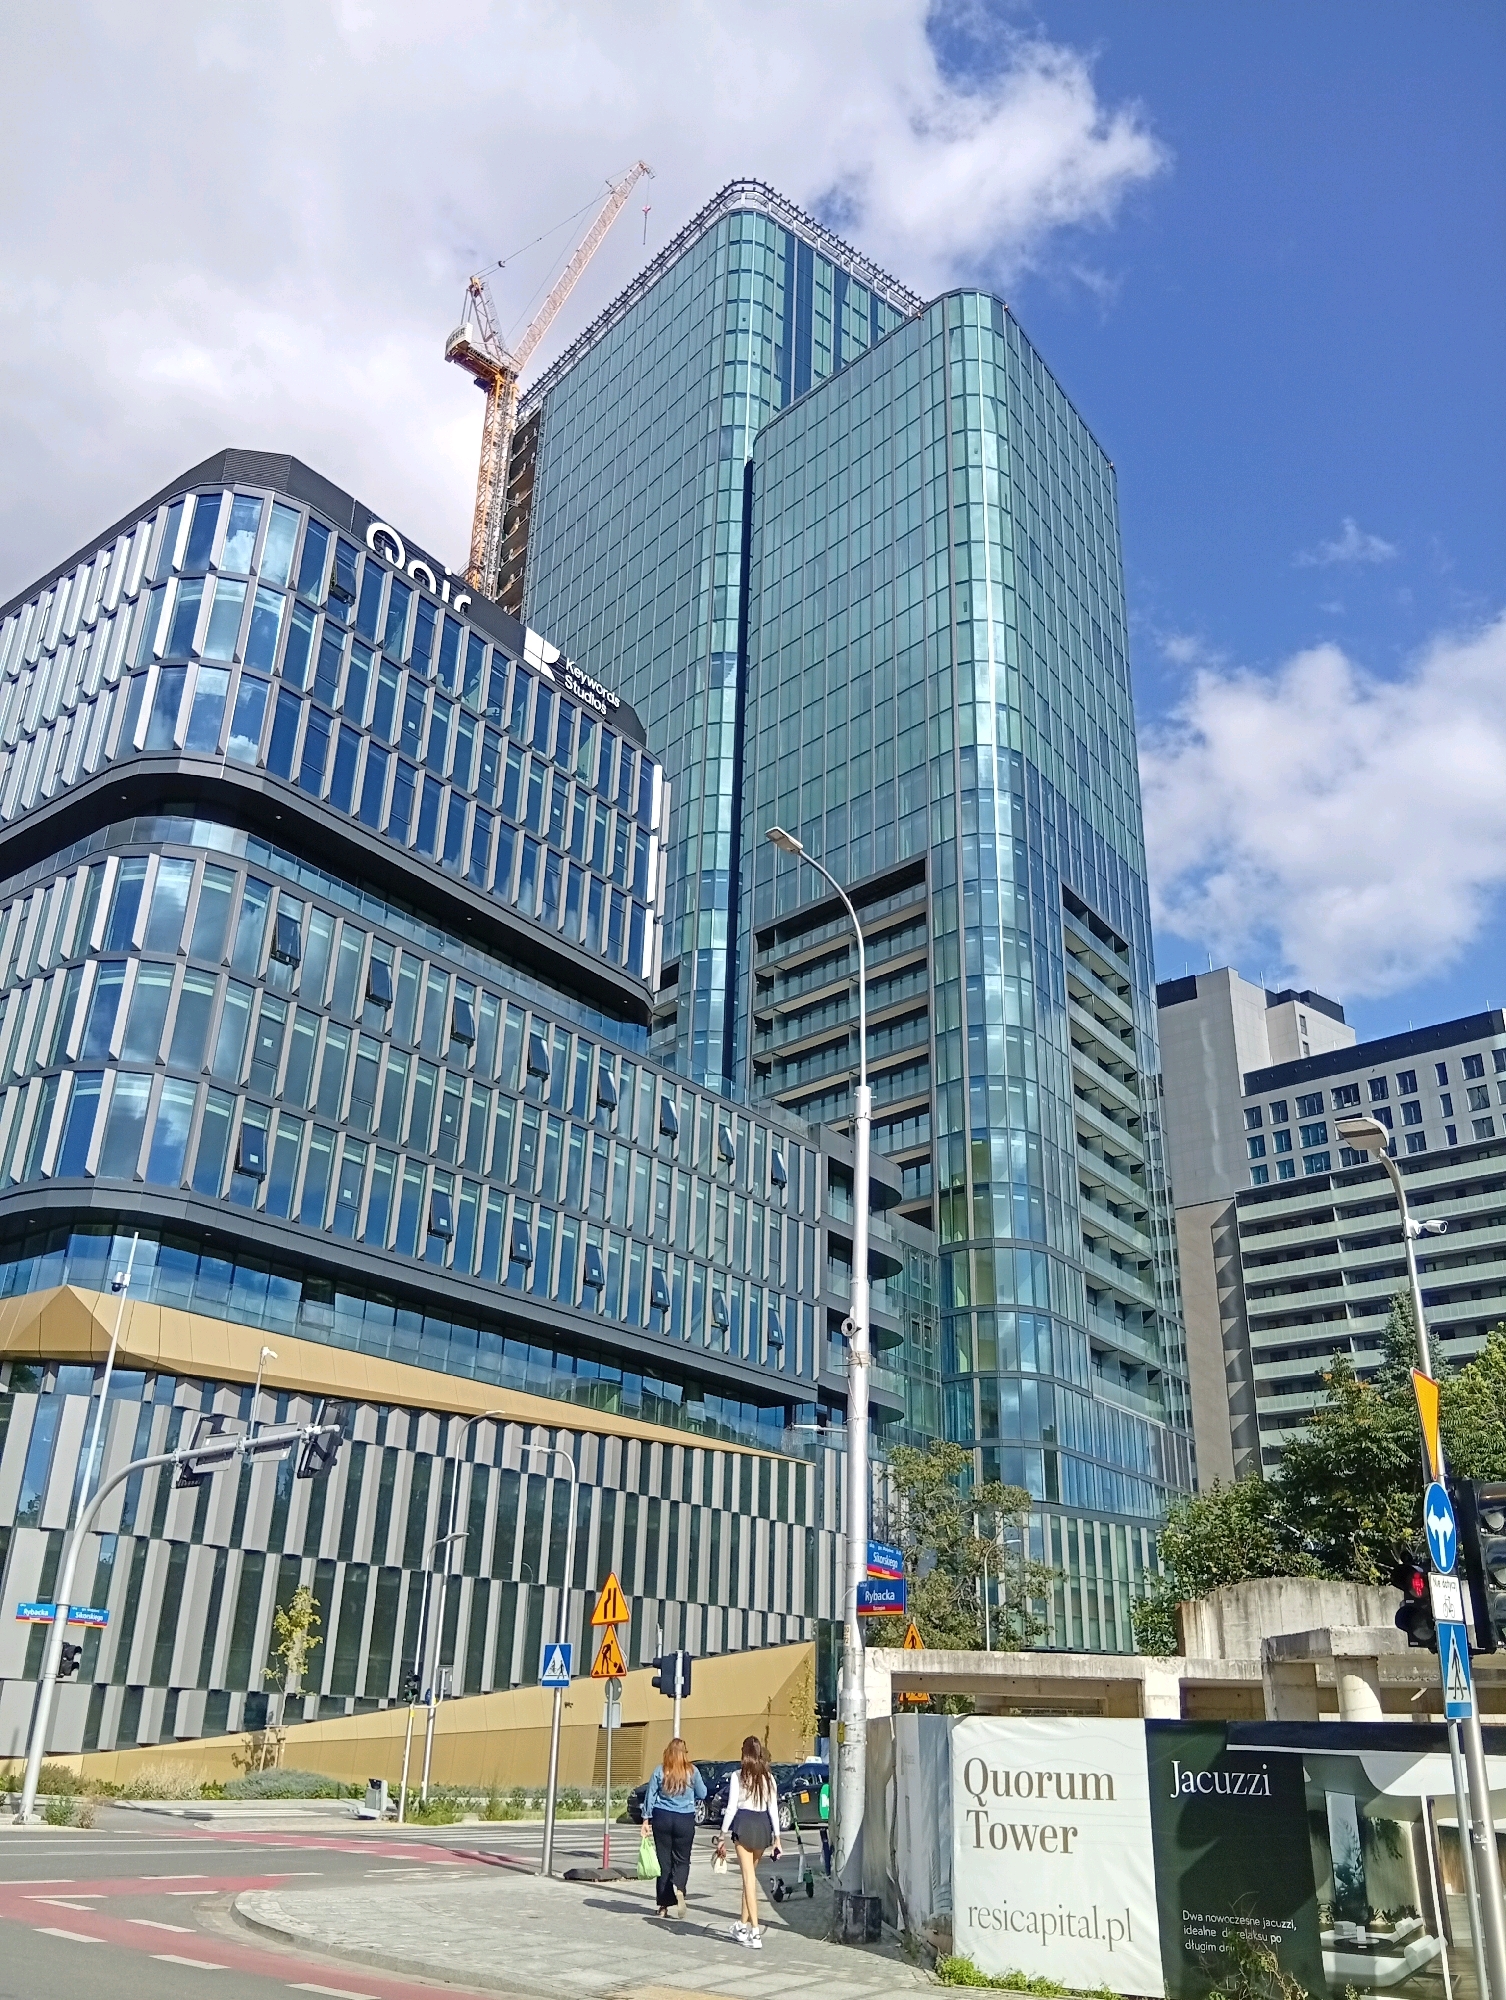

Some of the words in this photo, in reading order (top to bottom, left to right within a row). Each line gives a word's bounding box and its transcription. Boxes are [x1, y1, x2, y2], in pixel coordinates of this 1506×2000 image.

[566, 657, 620, 708] Keywords
[564, 674, 607, 715] Studios
[873, 1551, 899, 1570] Sikorskiego
[864, 1589, 895, 1604] Rybacka
[23, 1608, 49, 1617] Rybacka
[75, 1611, 104, 1623] Sikorskiego
[963, 1757, 1117, 1807] Quorum
[1170, 1760, 1272, 1798] Jacuzzi
[966, 1810, 1078, 1854] Tower
[968, 1900, 1134, 1952] resicapital.pl
[1182, 1909, 1203, 1922] Dwa
[1205, 1913, 1260, 1926] nowoczesne
[1262, 1917, 1297, 1931] jacuzzi,
[1183, 1925, 1217, 1937] idealne
[1236, 1928, 1267, 1942] relaksu
[1270, 1934, 1282, 1945] po
[1185, 1939, 1217, 1953] długim
